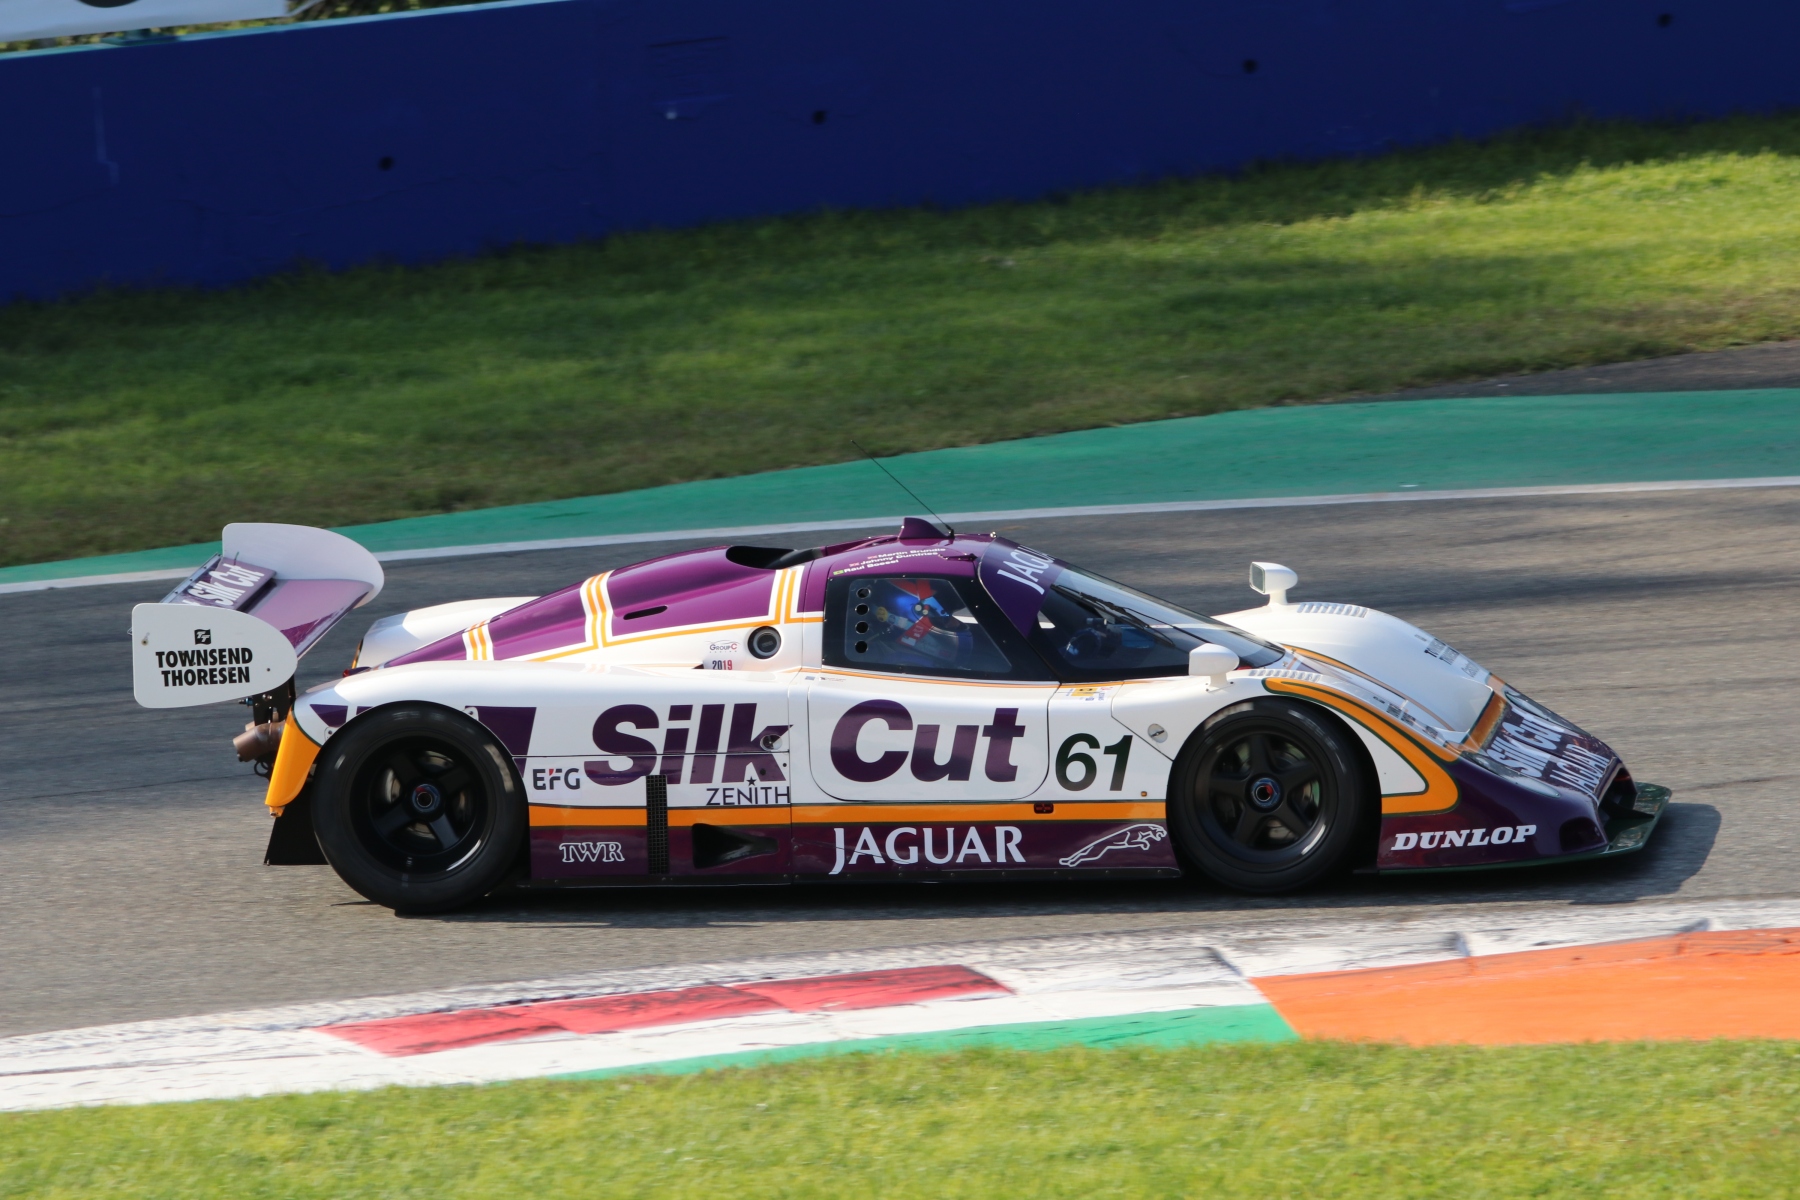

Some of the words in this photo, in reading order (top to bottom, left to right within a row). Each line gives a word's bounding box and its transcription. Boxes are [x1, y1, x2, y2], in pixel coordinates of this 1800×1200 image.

[208, 563, 265, 587] Cut
[843, 565, 865, 573] Raul
[187, 581, 246, 606] Silk
[155, 647, 253, 668] TOWNSEND
[712, 660, 733, 670] 2019
[161, 667, 250, 687] THORESEN
[1502, 707, 1565, 750] Cut
[584, 703, 794, 786] Silk
[830, 699, 1026, 782] Cut
[1055, 732, 1134, 792] 61
[1486, 736, 1551, 778] Silk
[532, 767, 581, 790] EFG
[1550, 744, 1610, 807] JAGUAR
[706, 786, 790, 805] ZENITH
[1391, 825, 1537, 851] DUNLOP
[559, 841, 625, 862] TWR
[829, 826, 1026, 875] JAGUAR
